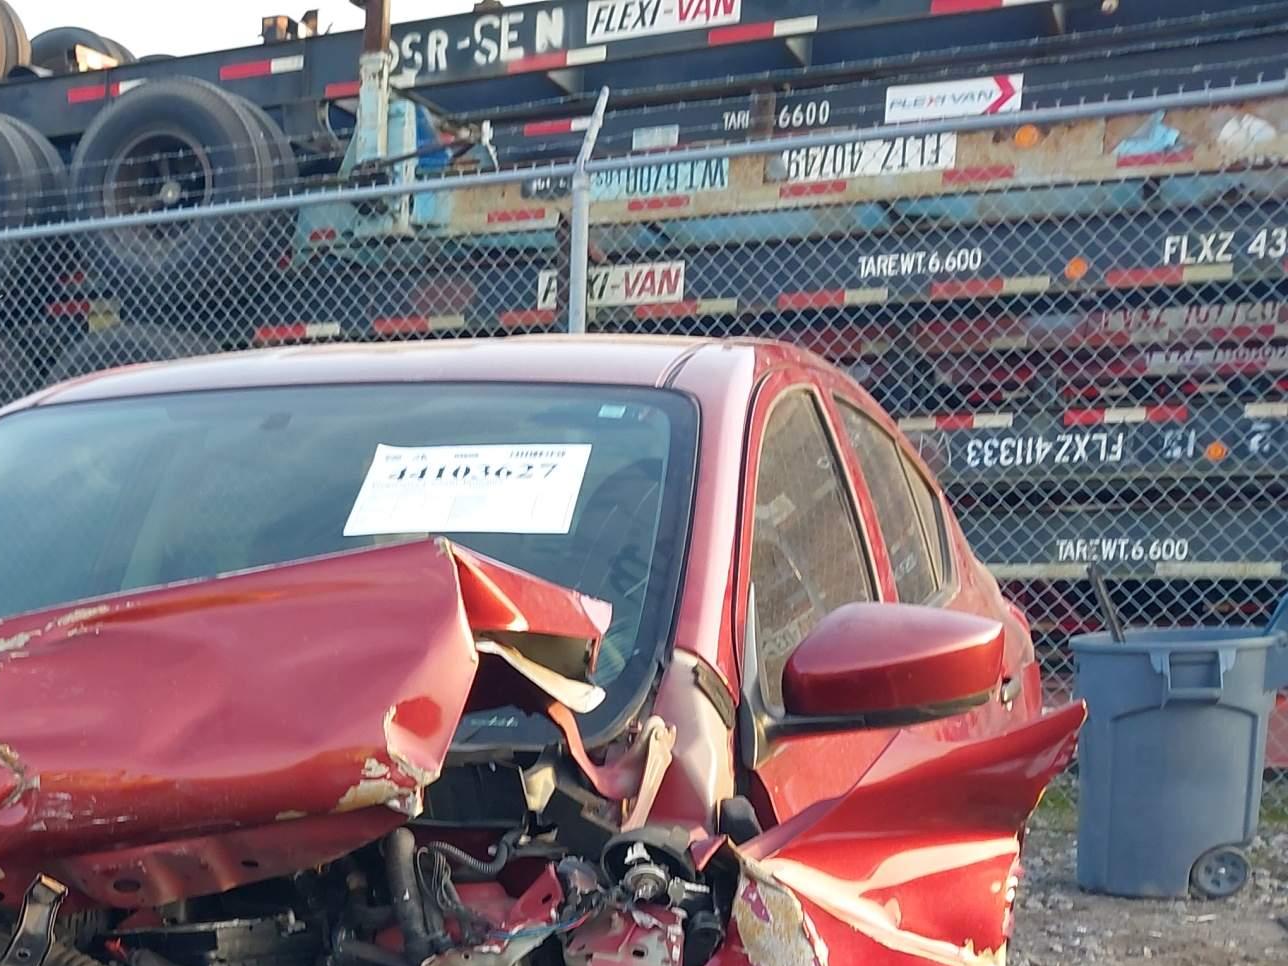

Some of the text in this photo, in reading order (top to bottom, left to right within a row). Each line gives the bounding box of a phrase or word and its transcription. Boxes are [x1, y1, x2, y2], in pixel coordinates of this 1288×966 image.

[591, 0, 736, 34] FLEXI-VAN
[778, 100, 830, 129] 6600
[1164, 231, 1235, 265] FLXZ
[542, 267, 681, 303] FXI-VAN
[967, 434, 1053, 467] 411333
[1055, 432, 1124, 464] FLXZ
